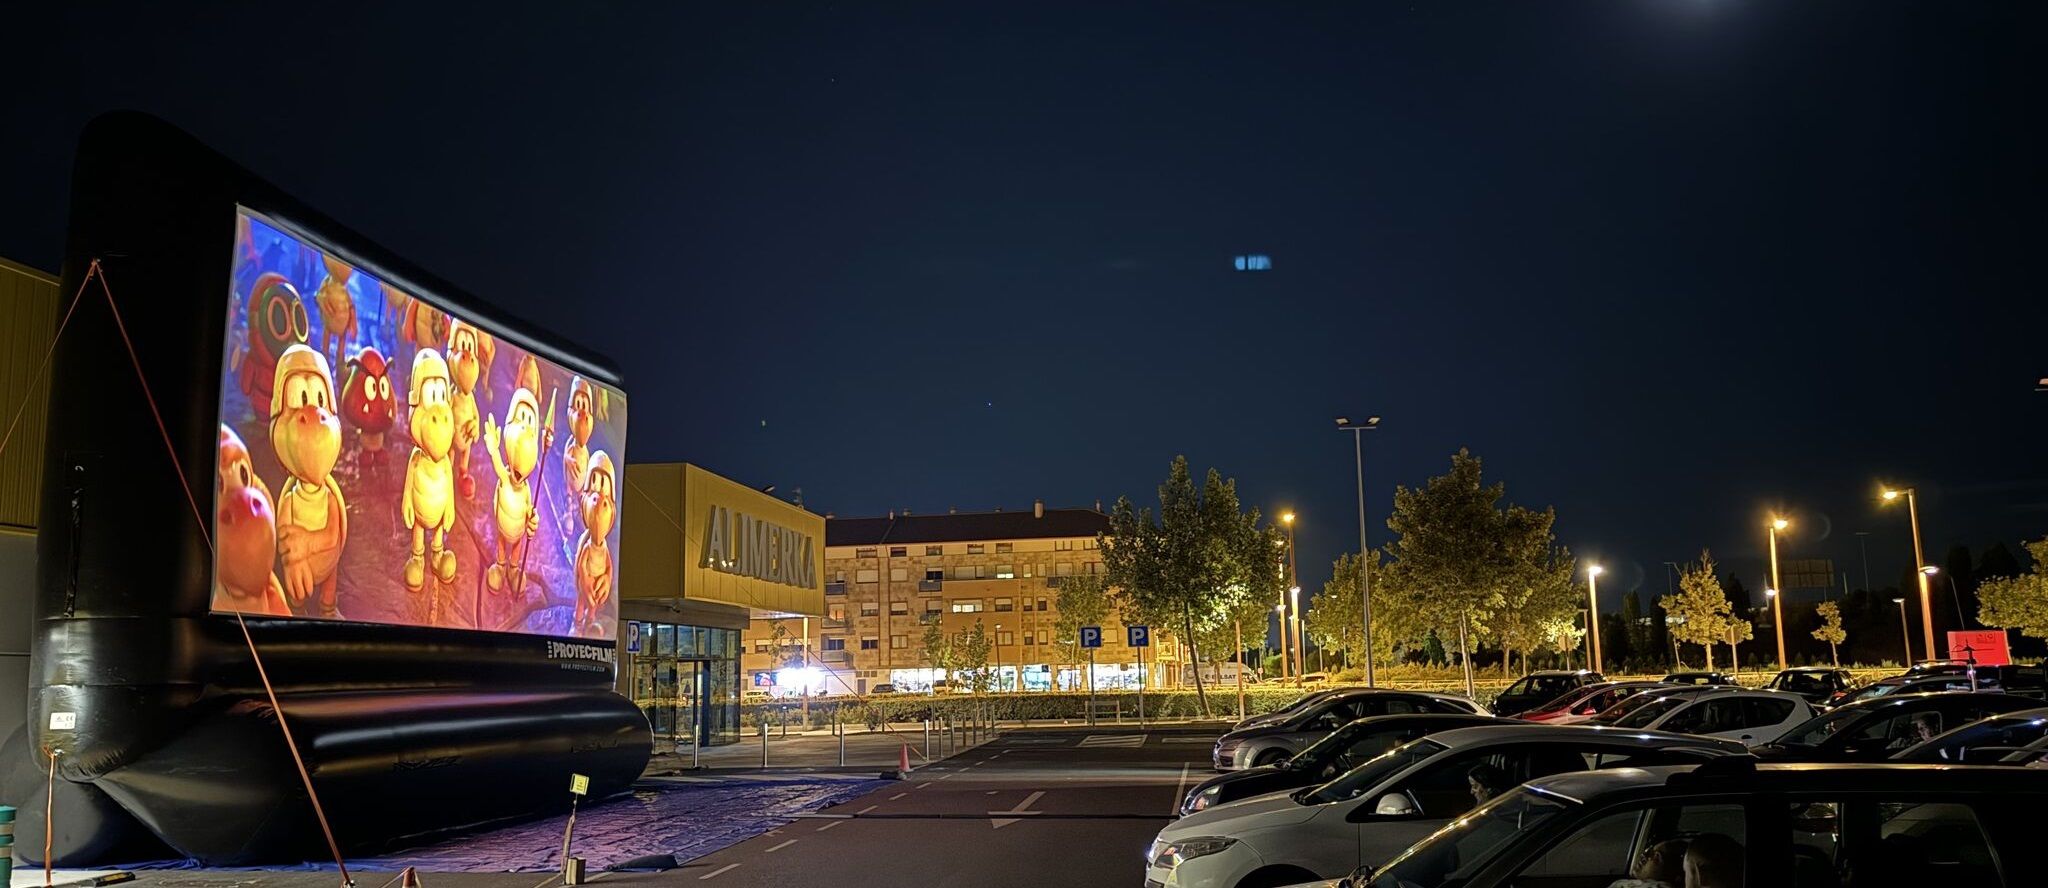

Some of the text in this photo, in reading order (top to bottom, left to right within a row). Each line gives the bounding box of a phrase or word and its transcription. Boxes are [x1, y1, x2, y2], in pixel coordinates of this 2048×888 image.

[701, 504, 817, 589] ALIMERKA
[630, 624, 639, 649] P
[1084, 628, 1098, 646] P
[1131, 627, 1145, 645] P
[552, 641, 613, 664] PROYECFILM
